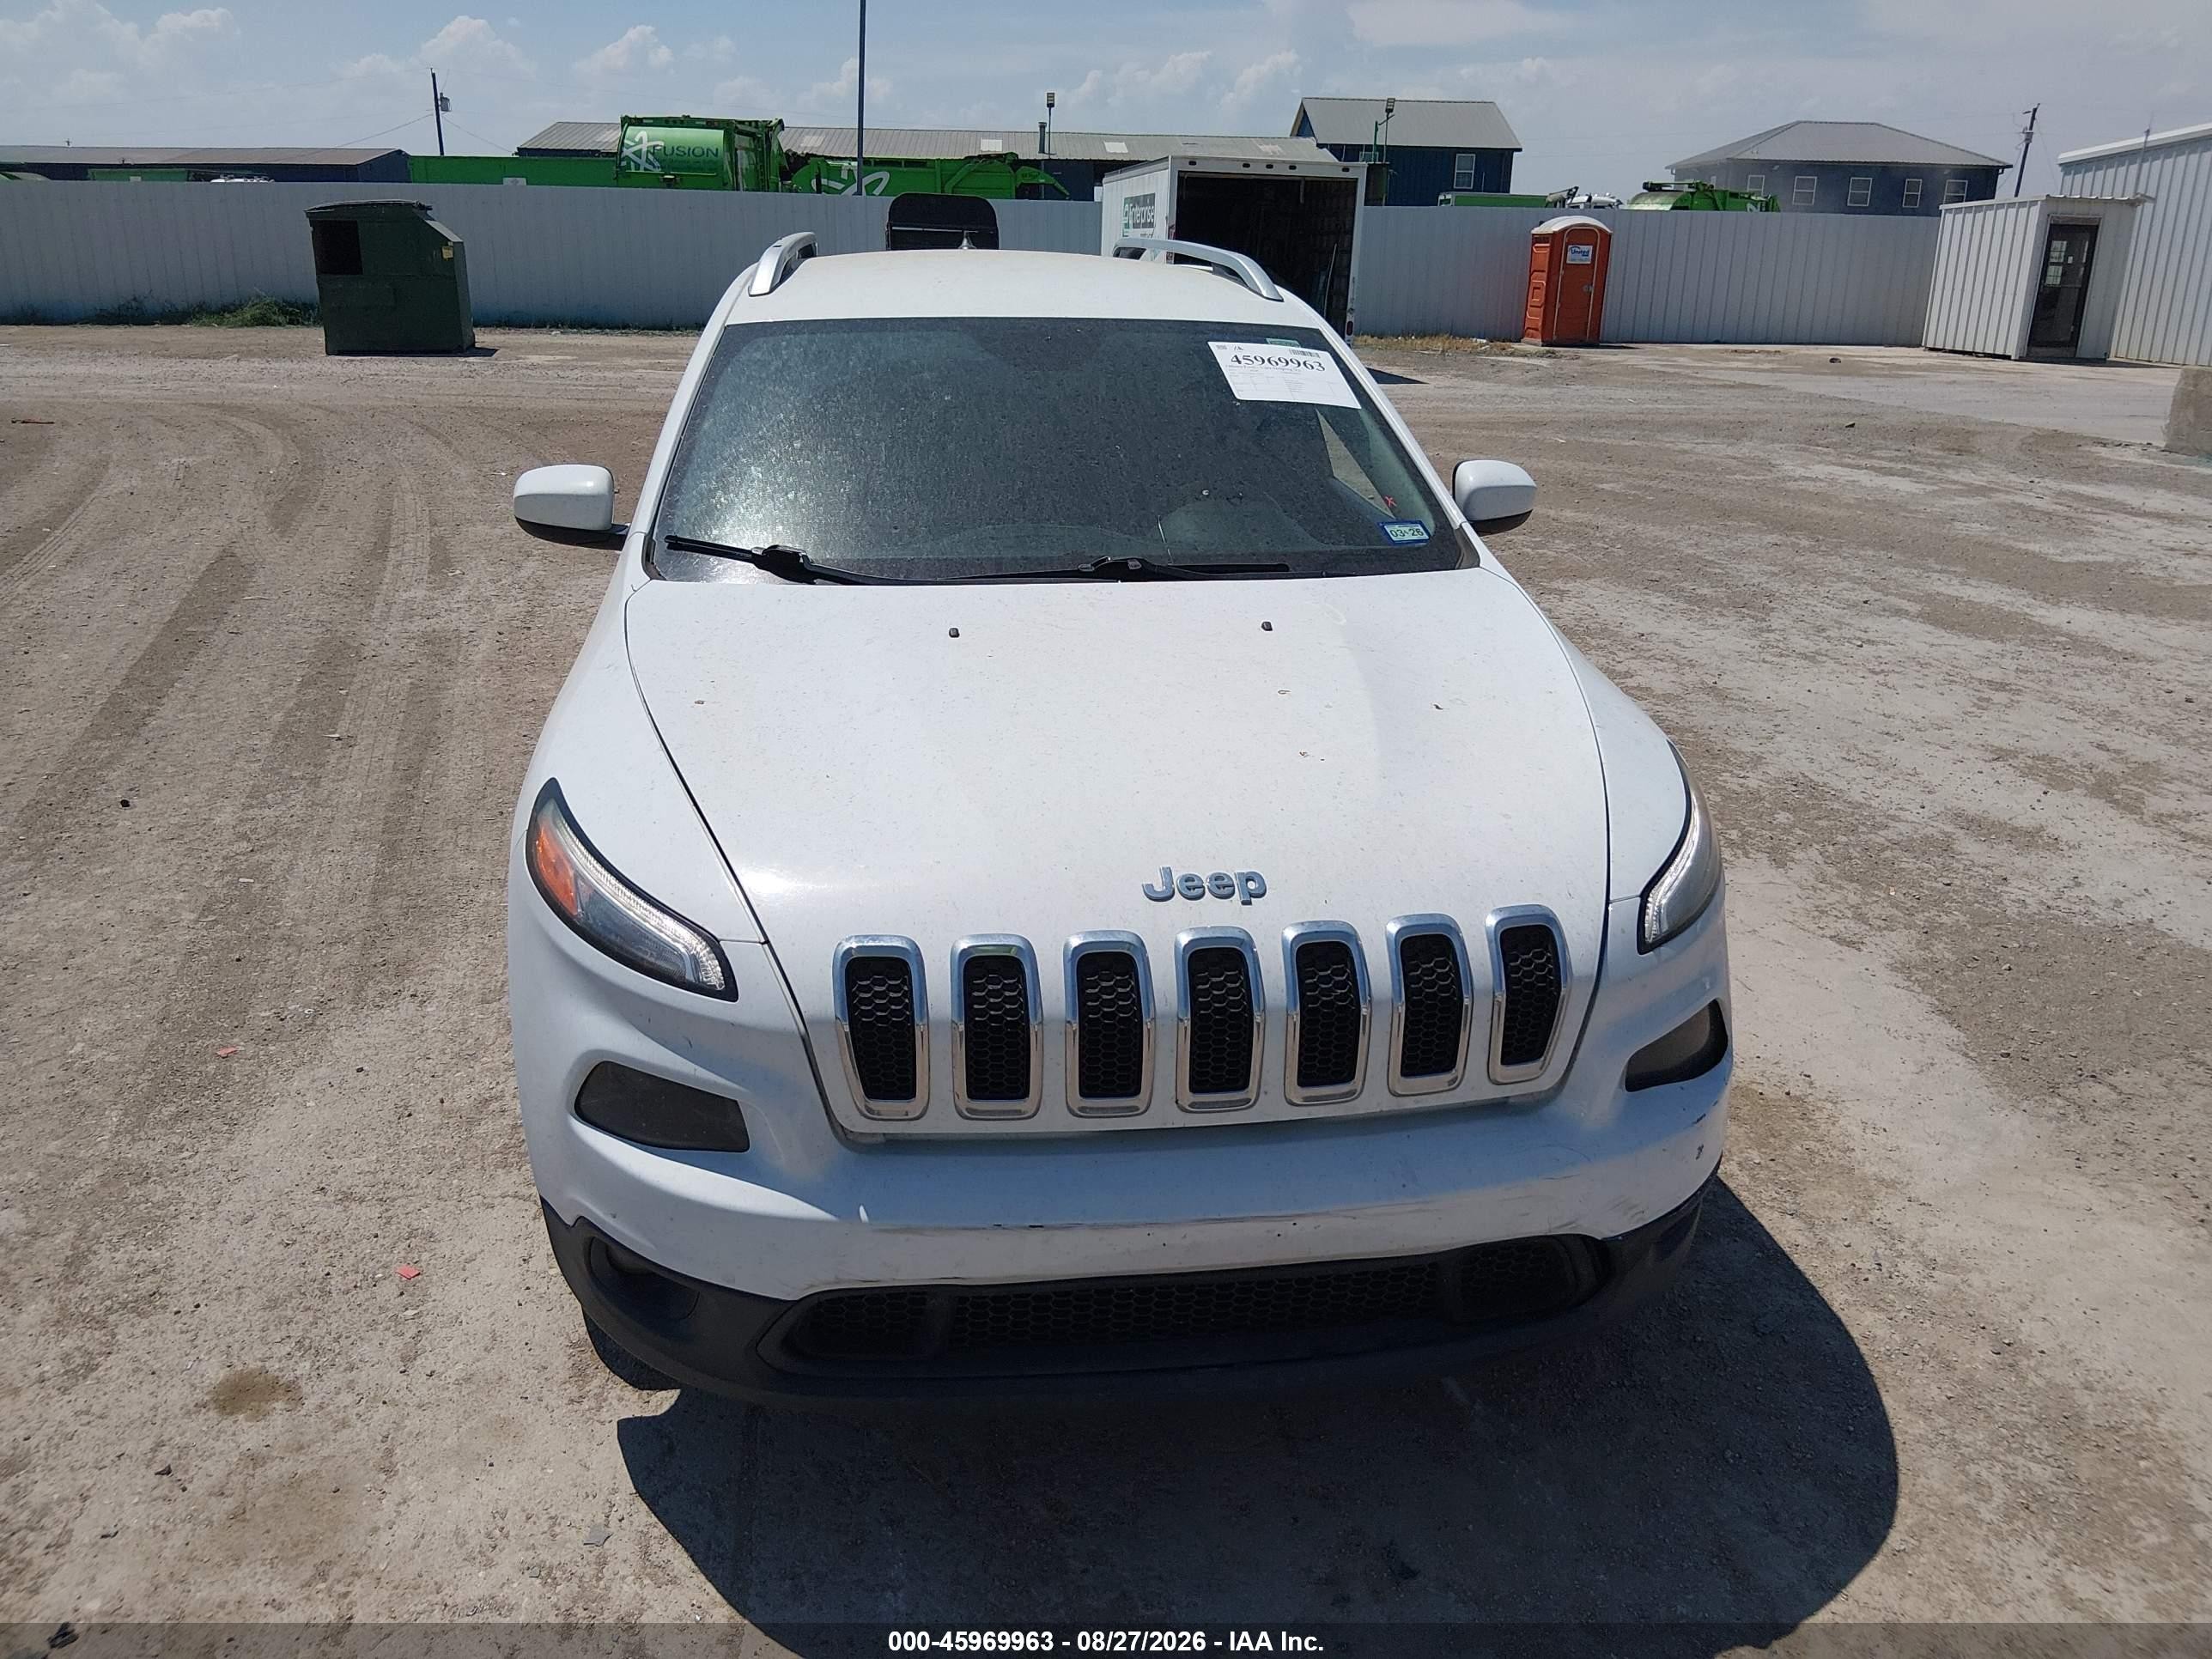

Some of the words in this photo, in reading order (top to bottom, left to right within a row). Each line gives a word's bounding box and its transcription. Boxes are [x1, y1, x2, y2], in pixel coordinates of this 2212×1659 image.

[653, 145, 719, 158] FUSION
[1231, 354, 1326, 372] 45969963
[1142, 866, 1267, 905] Jeep
